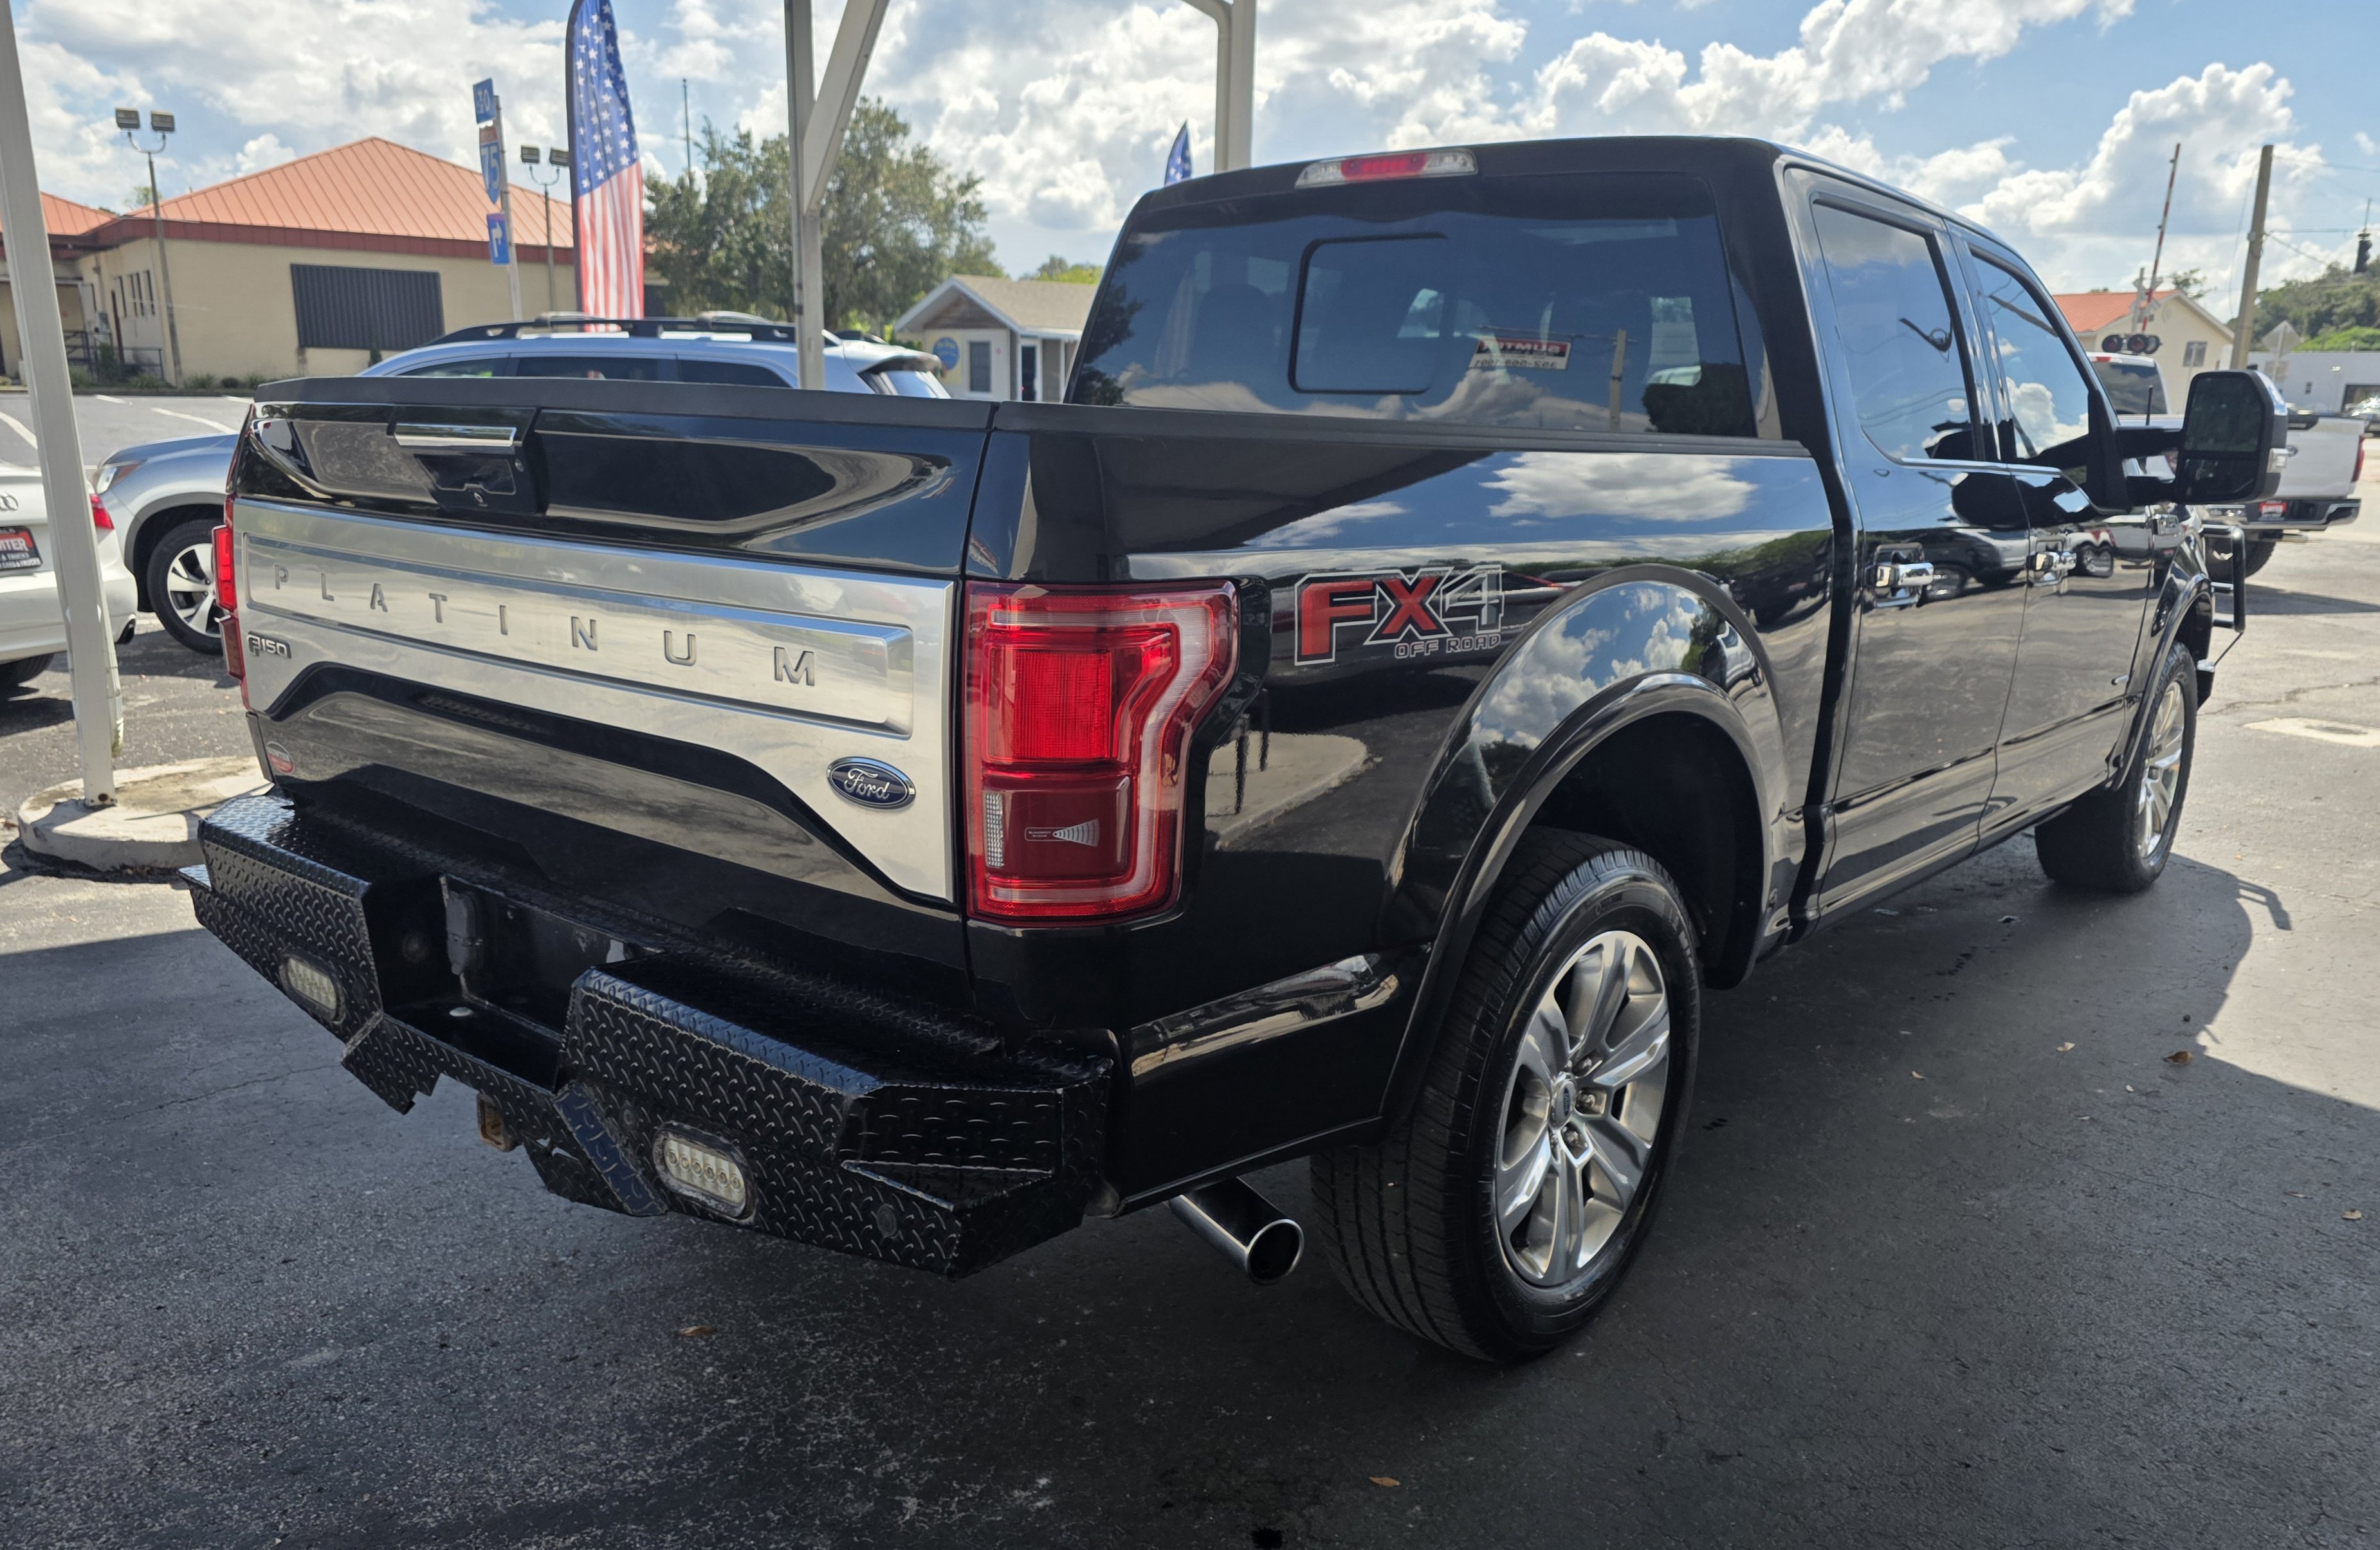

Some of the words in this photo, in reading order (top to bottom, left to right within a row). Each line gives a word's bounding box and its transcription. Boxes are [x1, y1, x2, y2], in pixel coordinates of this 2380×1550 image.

[481, 145, 500, 189] 75
[274, 563, 816, 686] PLATINUM
[1294, 564, 1504, 666] FX4
[1395, 639, 1439, 659] OFF
[1445, 633, 1501, 653] ROAD
[843, 767, 890, 800] Ford
